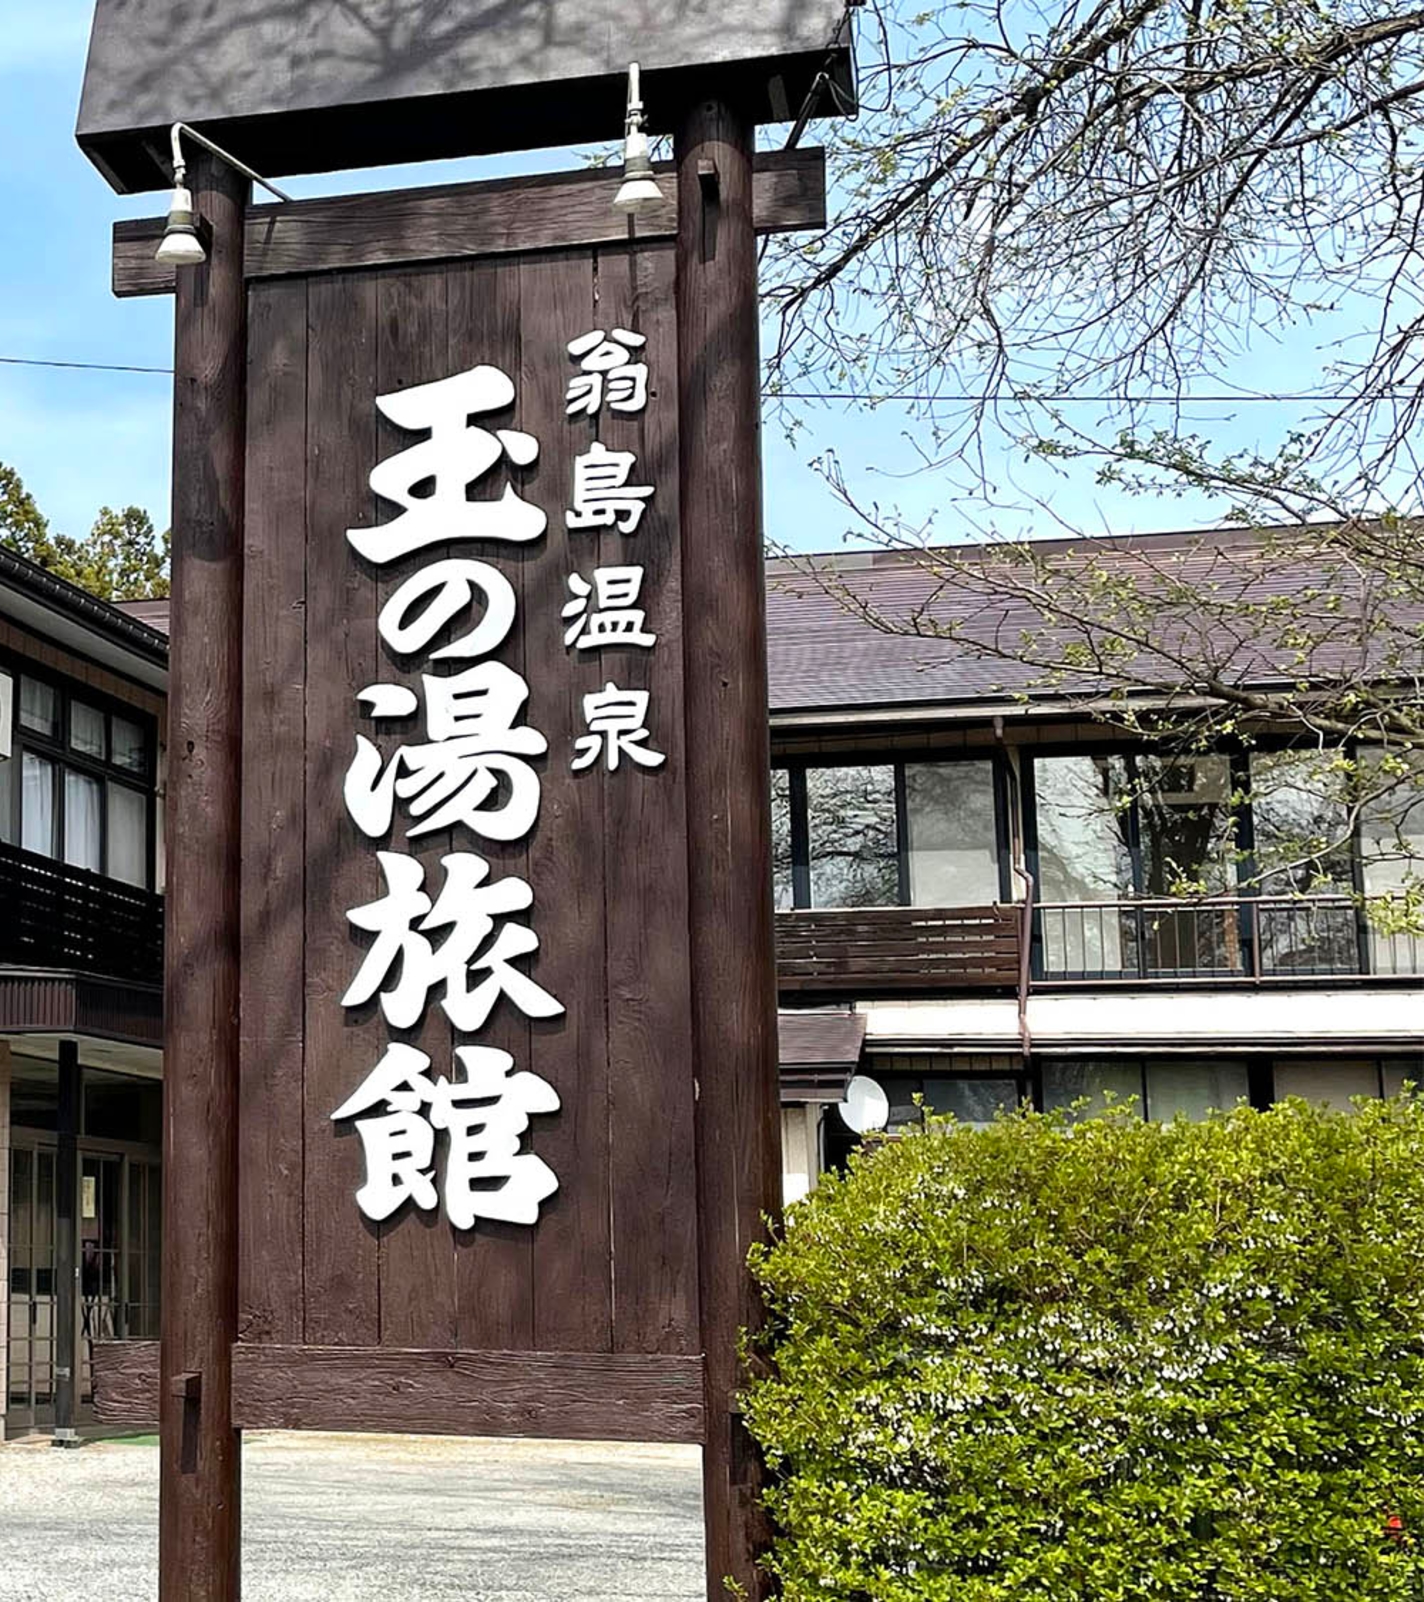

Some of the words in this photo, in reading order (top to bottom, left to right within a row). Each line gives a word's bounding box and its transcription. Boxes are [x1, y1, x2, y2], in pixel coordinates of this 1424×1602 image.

[330, 365, 566, 1230] 玉の湯旅館
[562, 328, 666, 771] 翁島温泉
